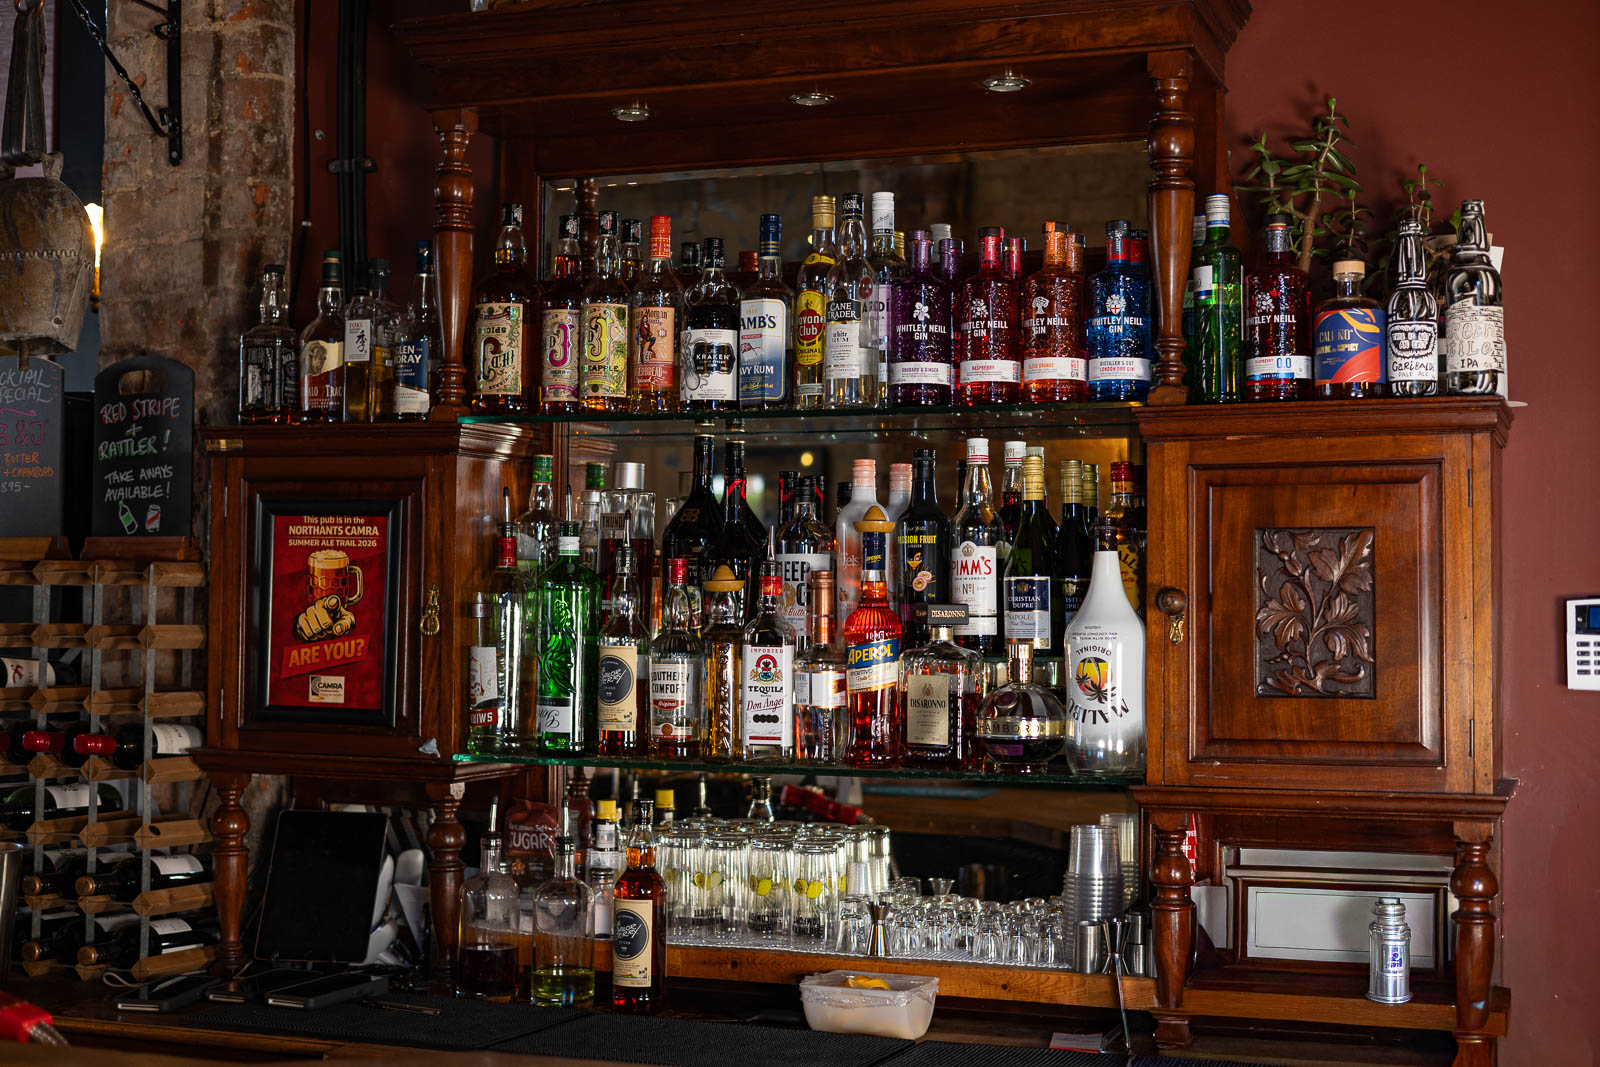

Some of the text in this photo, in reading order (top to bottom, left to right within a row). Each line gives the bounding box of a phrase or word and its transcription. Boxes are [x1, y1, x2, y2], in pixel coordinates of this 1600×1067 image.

[829, 302, 852, 312] CANE
[800, 315, 826, 325] avana
[828, 310, 861, 320] TRADER
[1274, 314, 1297, 323] NEILL
[740, 313, 777, 330] AMB'S
[987, 320, 1009, 329] NEILL
[1046, 317, 1069, 326] NEILL
[1123, 316, 1144, 326] NEILL
[799, 326, 818, 337] Club
[896, 324, 947, 334] WHITLEY NEILL
[973, 329, 987, 337] GIN
[1033, 326, 1046, 335] GIN
[1108, 324, 1124, 334] GIN
[914, 332, 928, 341] GIN
[396, 354, 422, 364] ORAY
[695, 353, 730, 361] KRAKEN
[1460, 358, 1479, 369] IPA
[754, 365, 774, 375] RUM
[0, 369, 51, 388] CKTAIL
[0, 386, 53, 404] PECIAL
[325, 384, 343, 397] TRAC
[99, 396, 181, 425] RED STRIPE
[4, 451, 40, 466] BUTTER
[104, 464, 174, 486] TAKE AWAYS
[303, 514, 365, 526] This pub is in the
[288, 525, 379, 536] NORTHANTS CAMRA
[288, 538, 377, 548] SUMMER ALE TRAIL 2026
[919, 534, 937, 544] FRUIT
[951, 555, 992, 577] PIMM'S
[783, 561, 811, 582] EEP
[931, 610, 966, 619] DISARONNO
[288, 638, 366, 669] ARE YOU?
[848, 643, 894, 665] APEROL
[1075, 645, 1112, 657] ORIGINAL
[317, 681, 343, 690] CAMRA
[748, 685, 784, 695] TEQUILA
[746, 700, 762, 713] Don
[910, 698, 946, 709] DISARONNO
[1068, 697, 1130, 725] MALIBU
[978, 721, 1041, 734] HAMBORD
